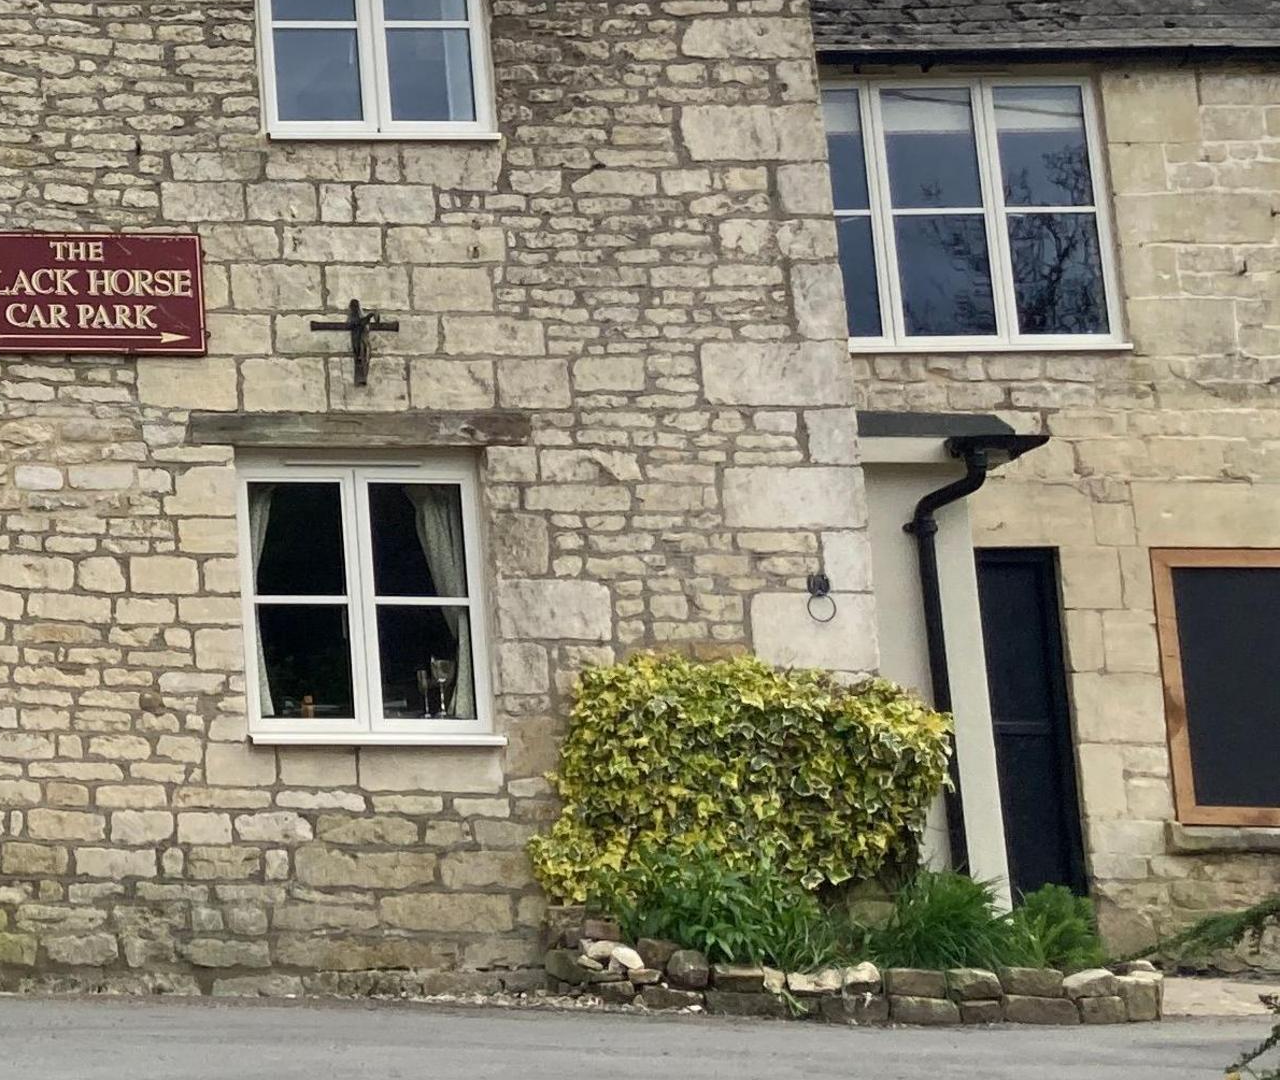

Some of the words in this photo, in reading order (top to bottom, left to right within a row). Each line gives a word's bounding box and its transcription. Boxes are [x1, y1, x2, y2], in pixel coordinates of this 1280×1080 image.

[50, 241, 104, 262] THE
[86, 269, 193, 298] HORSE
[5, 303, 71, 329] CAR
[76, 304, 158, 329] PARK
